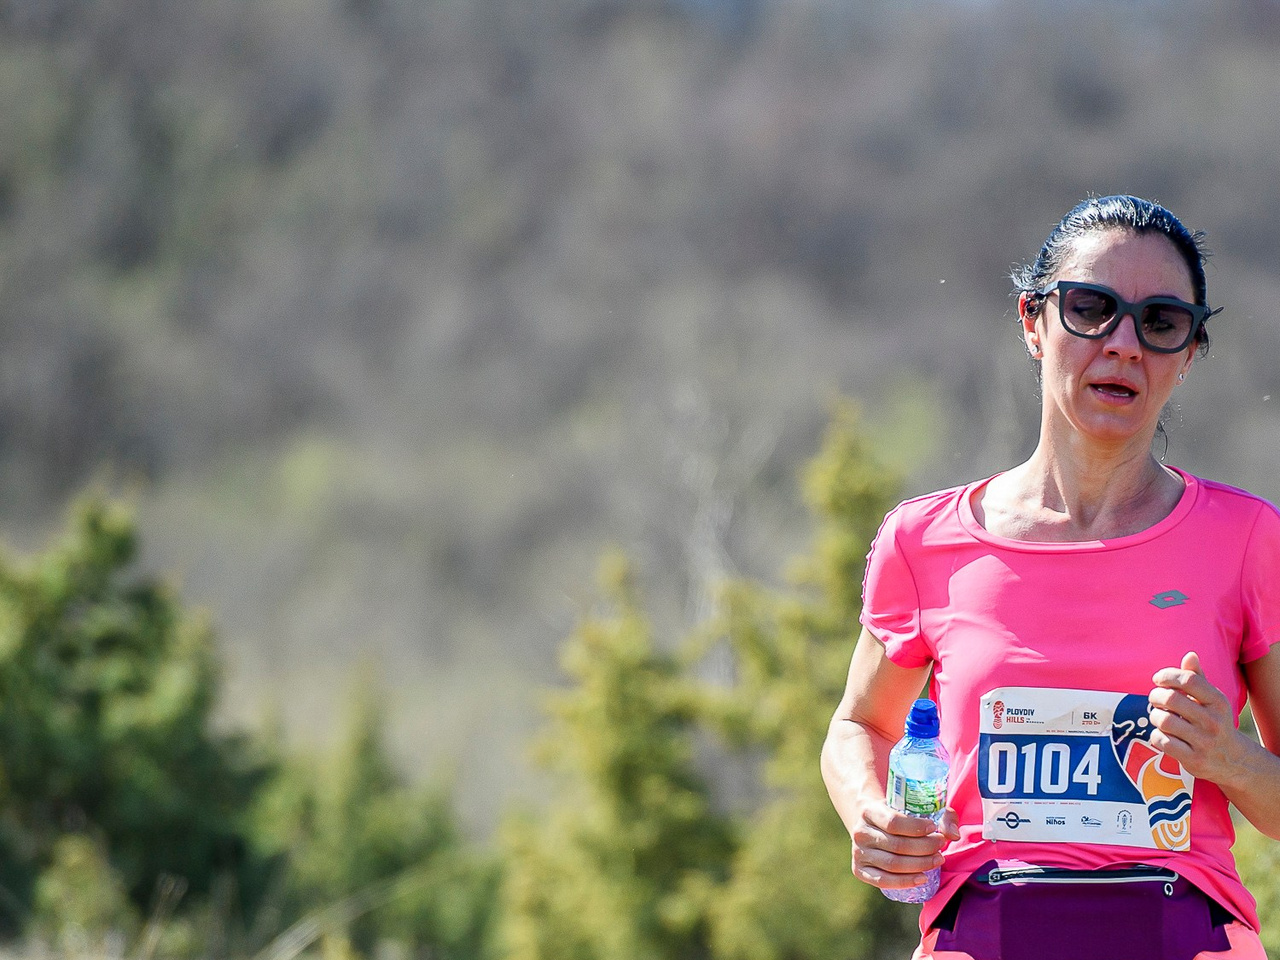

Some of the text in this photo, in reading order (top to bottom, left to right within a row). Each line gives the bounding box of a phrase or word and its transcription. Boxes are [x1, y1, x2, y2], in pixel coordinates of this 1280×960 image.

[1006, 708, 1034, 716] PLOVDIV
[1083, 711, 1097, 719] 6K
[988, 741, 1101, 795] 0104
